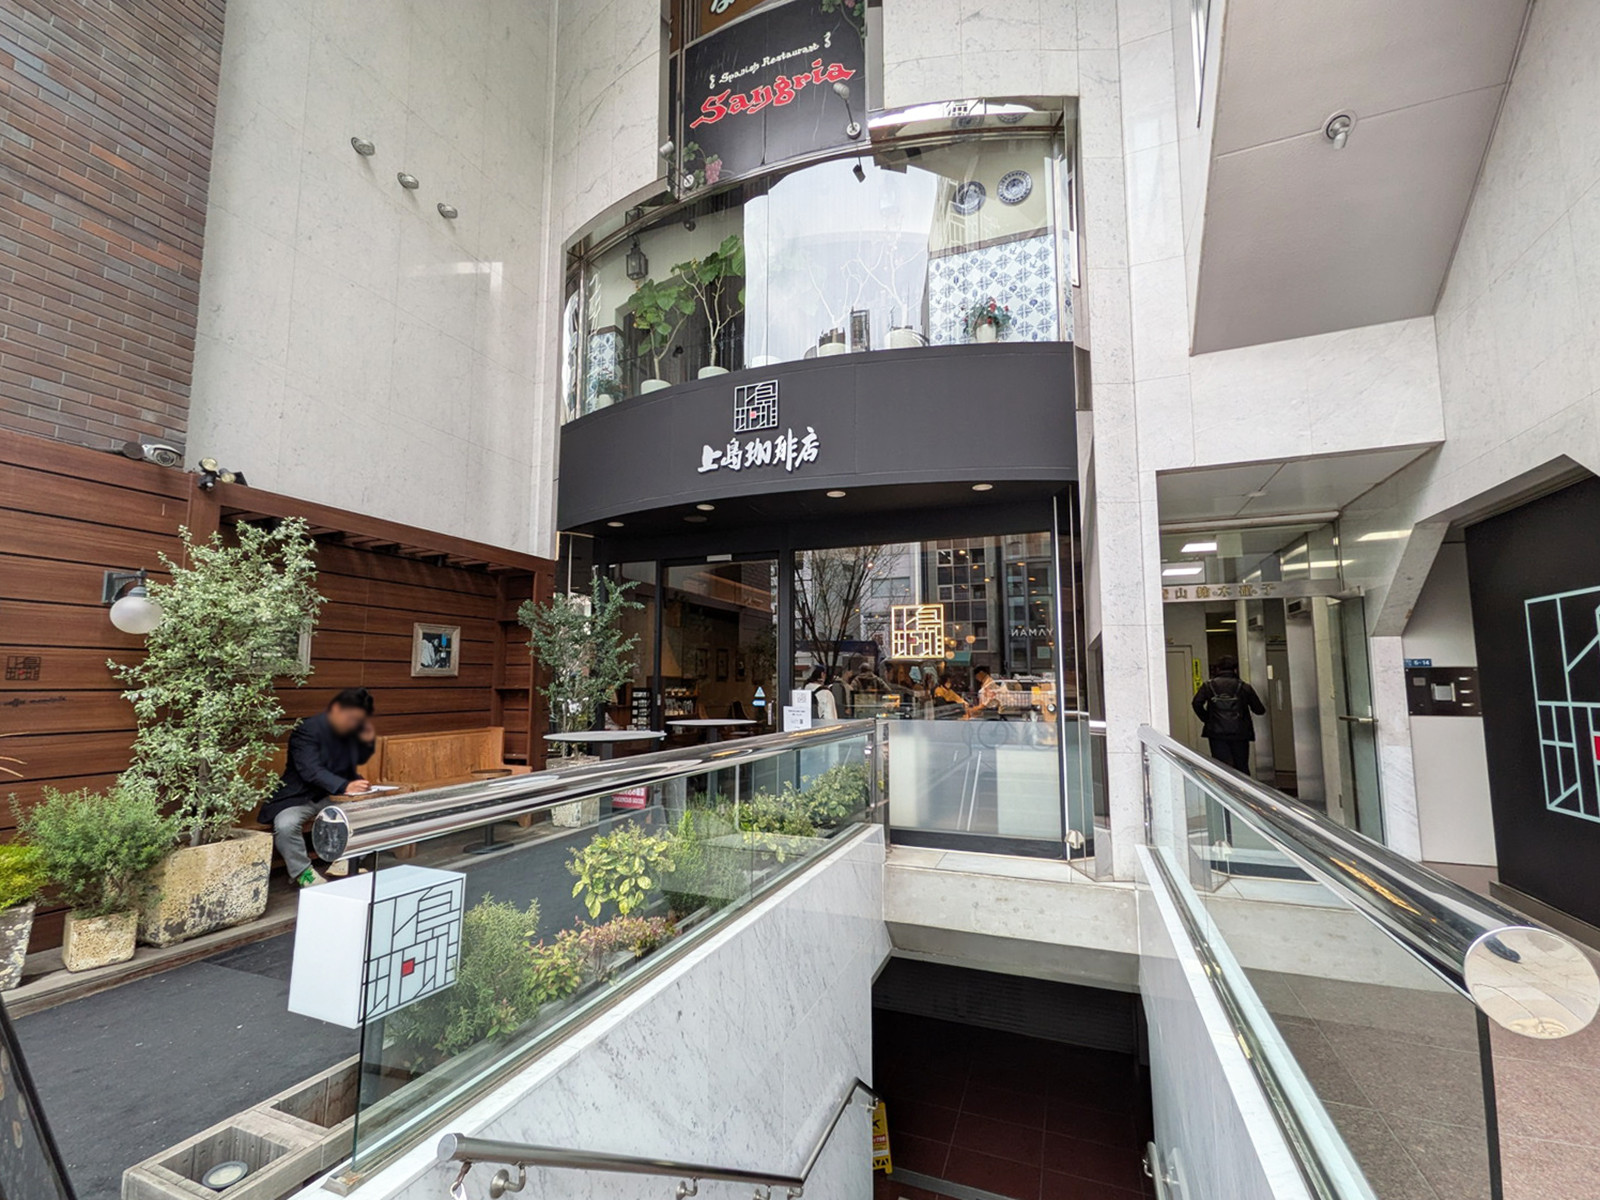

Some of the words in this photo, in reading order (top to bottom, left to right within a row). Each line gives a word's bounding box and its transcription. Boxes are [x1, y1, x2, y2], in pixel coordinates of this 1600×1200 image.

[718, 62, 760, 84] Spanish
[761, 42, 819, 69] Restaurant
[689, 58, 856, 129] Sangria
[697, 426, 820, 473] 上島珈琲店
